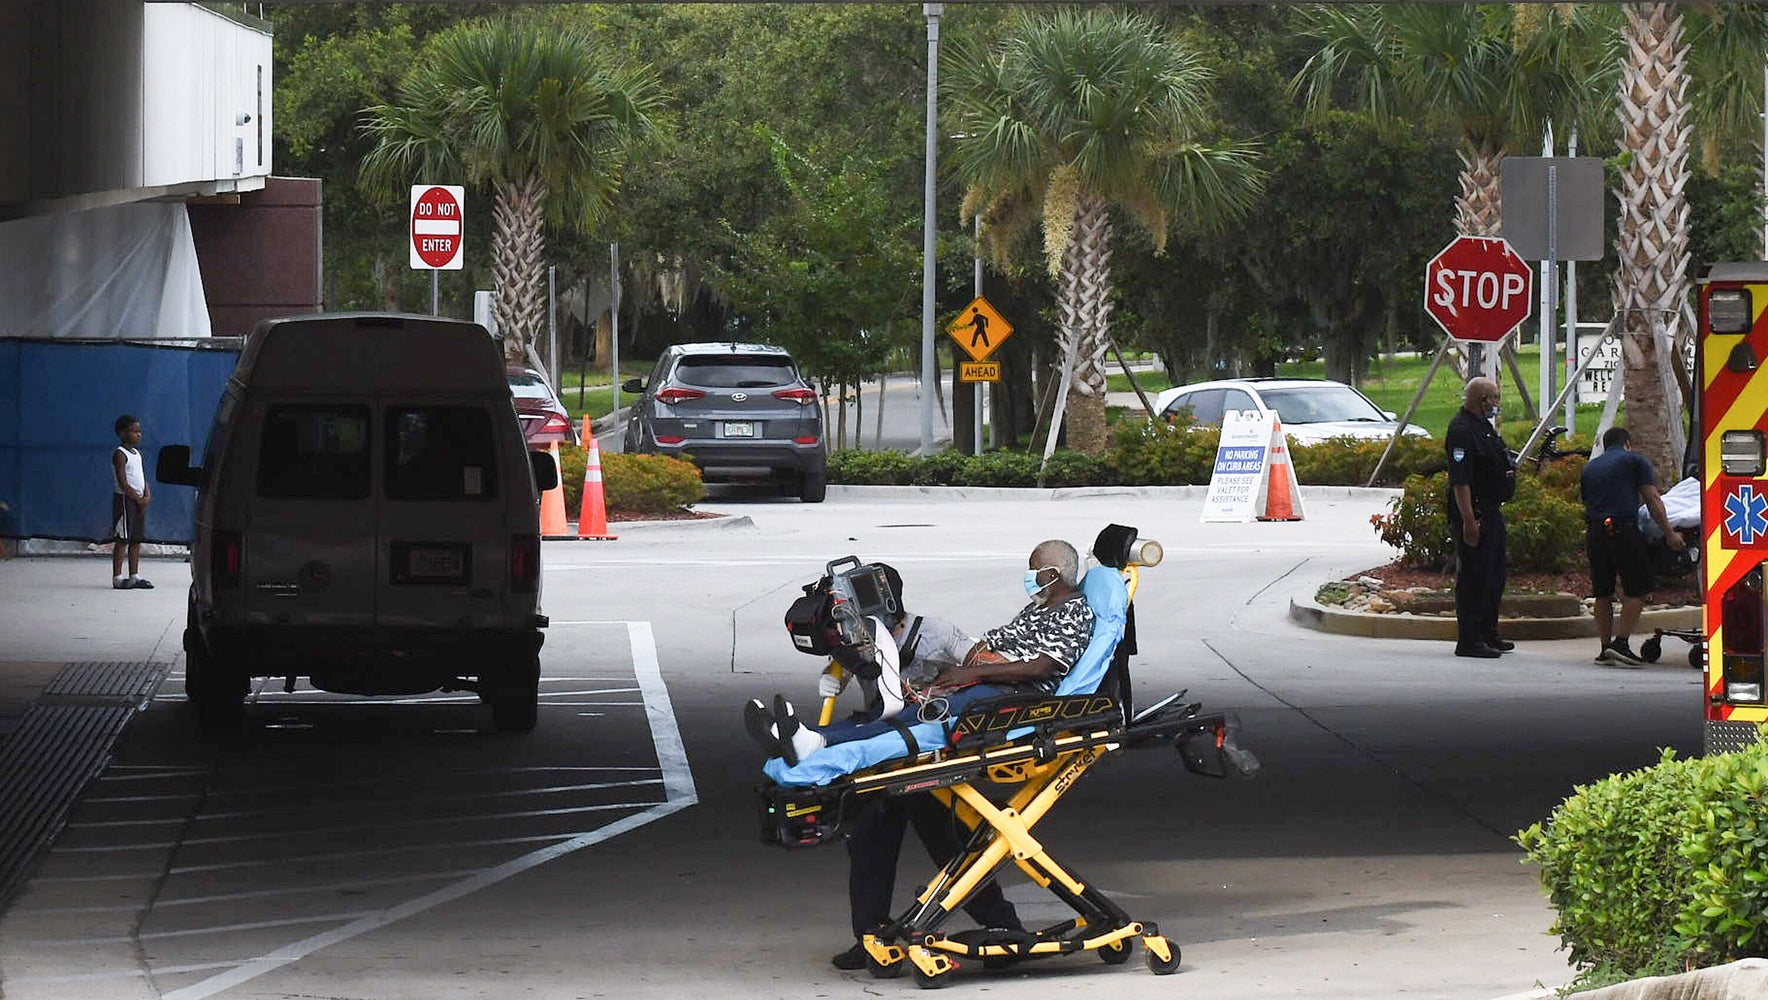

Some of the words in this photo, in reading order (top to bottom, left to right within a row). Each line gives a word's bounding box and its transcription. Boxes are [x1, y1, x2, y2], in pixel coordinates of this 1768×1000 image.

[419, 203, 433, 215] DO
[438, 203, 455, 215] NOT
[422, 239, 452, 252] ENTER
[1434, 268, 1525, 310] STOP
[965, 366, 996, 377] AHEAD
[1585, 370, 1612, 381] WELC
[1225, 450, 1233, 460] NO
[1234, 450, 1258, 460] PARKING
[1217, 461, 1226, 471] ON
[1227, 461, 1242, 471] CURB
[1243, 461, 1262, 471] AREAS
[1217, 486, 1237, 494] VALET
[1237, 486, 1250, 494] FOR
[1211, 495, 1249, 503] ASSISTANCE
[1054, 749, 1096, 796] stryker
